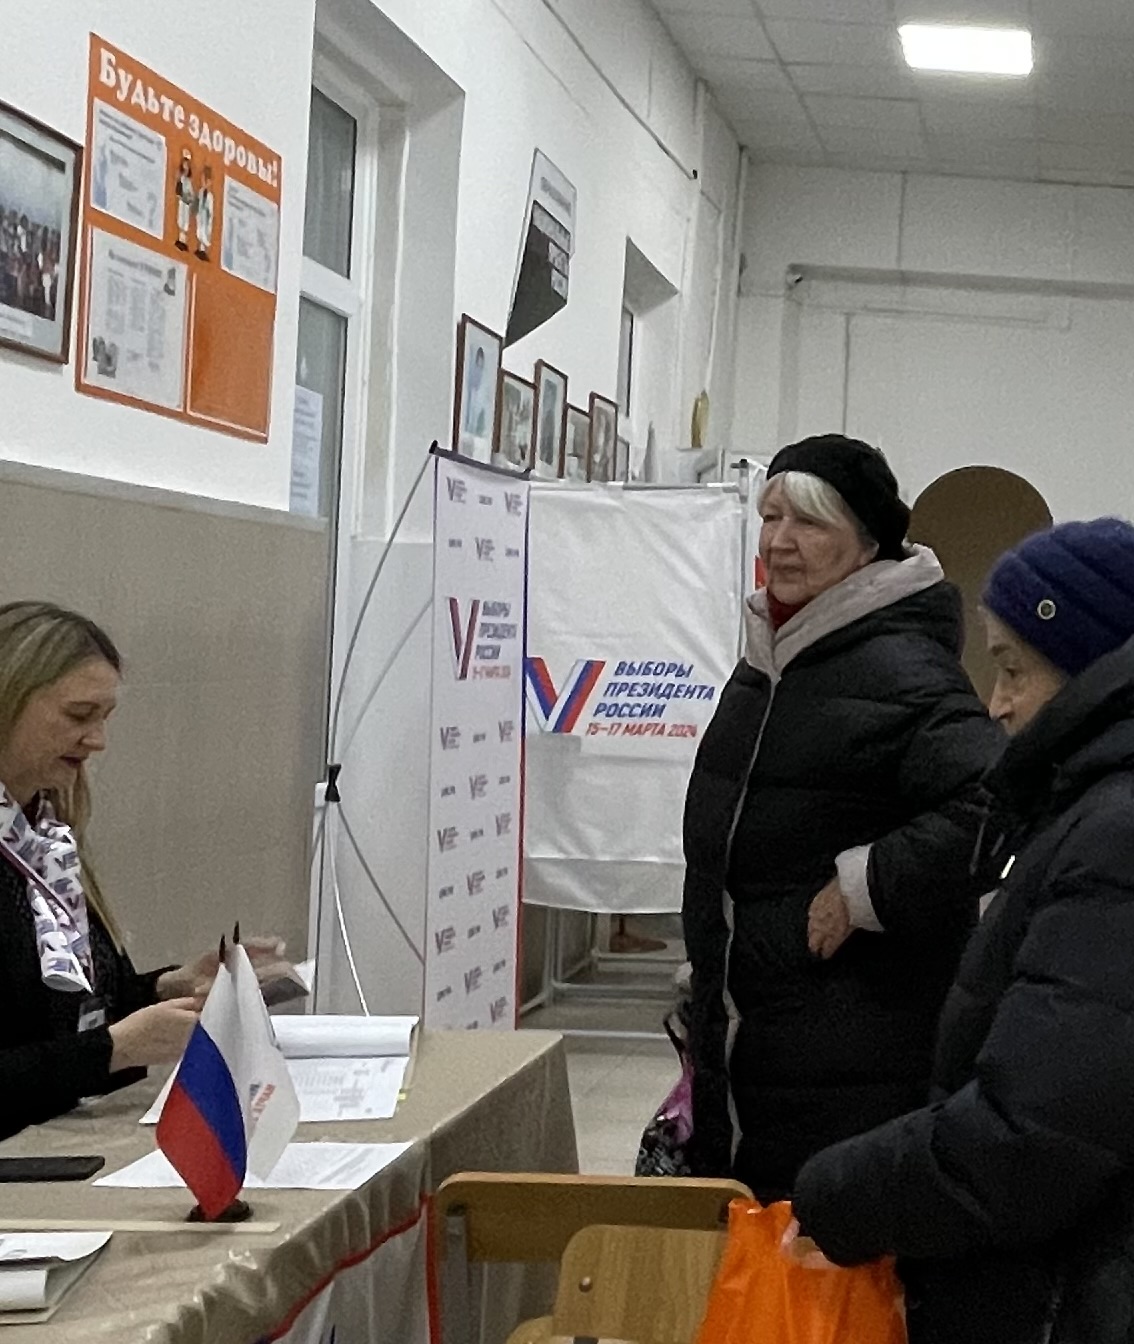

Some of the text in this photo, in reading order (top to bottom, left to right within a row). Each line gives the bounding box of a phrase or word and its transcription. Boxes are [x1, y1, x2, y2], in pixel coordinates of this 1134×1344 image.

[98, 47, 186, 130] Будьте
[188, 112, 278, 188] здоровы!
[614, 660, 694, 678] ВЫБОРЫ
[602, 681, 716, 701] ПРЕЗИДЕНТА
[592, 702, 667, 719] РОССИИ
[622, 722, 667, 737] МАРТА
